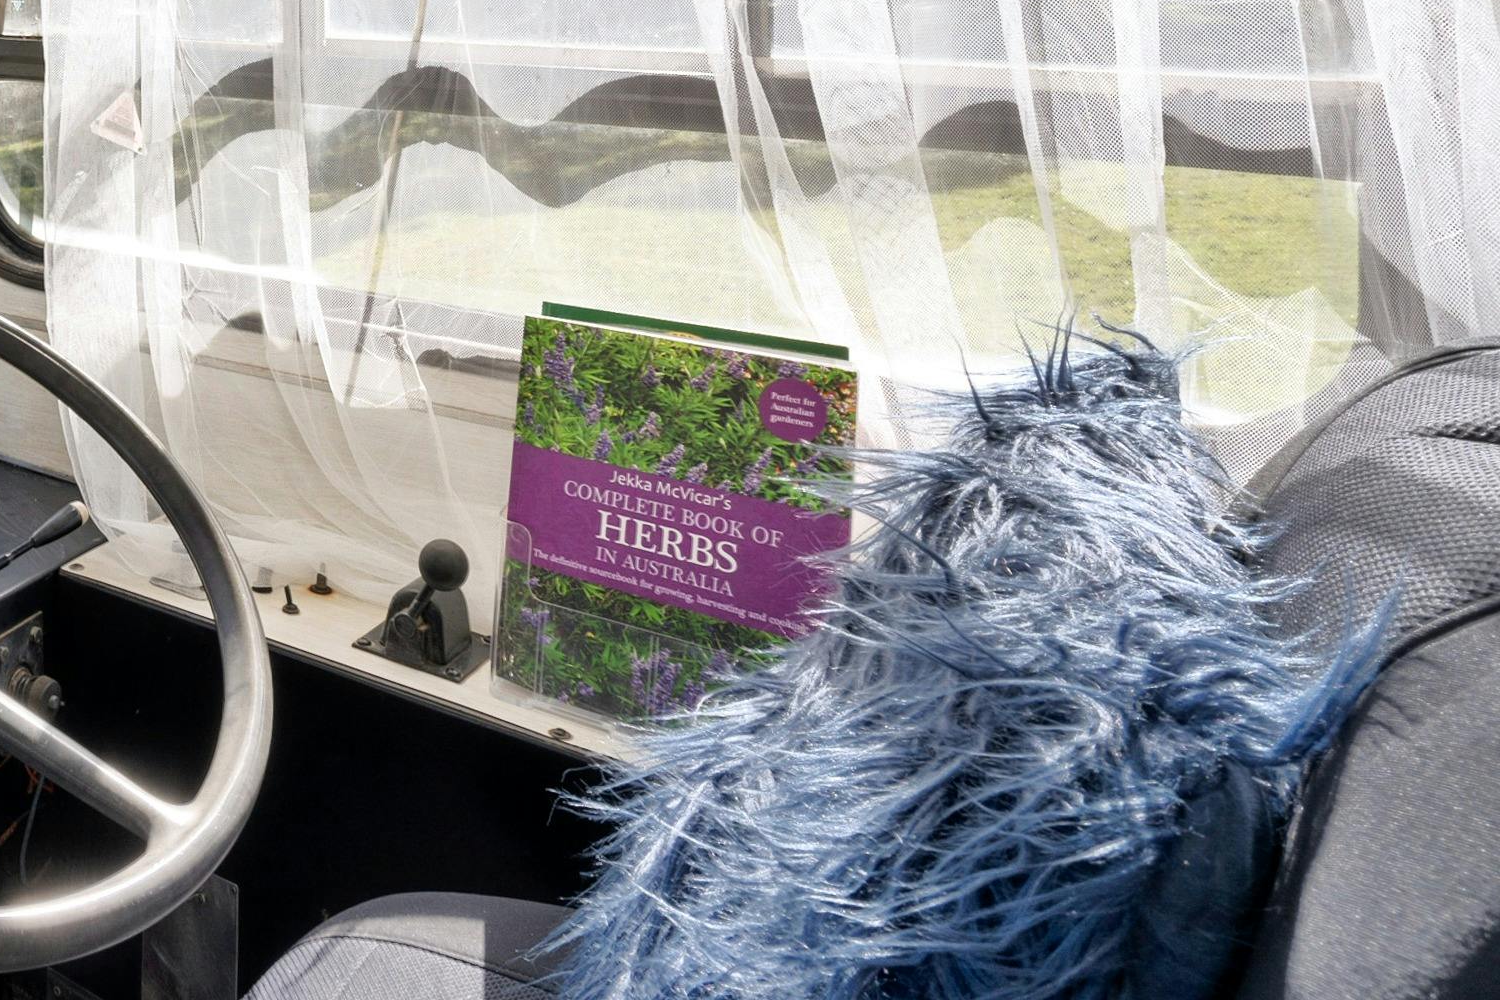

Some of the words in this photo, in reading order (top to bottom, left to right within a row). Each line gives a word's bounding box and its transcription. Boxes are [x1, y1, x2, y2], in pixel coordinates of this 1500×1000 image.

[770, 402, 815, 417] Australian
[770, 414, 814, 428] gardeners
[771, 391, 801, 404] Perfect
[803, 397, 816, 407] for
[609, 470, 652, 492] Jekka
[656, 480, 732, 511] McVicar's
[564, 480, 675, 522] COMPLETE
[681, 507, 745, 539] BOOK
[752, 525, 784, 548] OF
[595, 509, 738, 573] HERBS
[533, 548, 549, 560] The
[550, 554, 587, 571] definitive
[589, 566, 638, 585] sourcebook
[639, 577, 653, 590] for
[697, 594, 746, 619] harvesting
[747, 611, 767, 622] and
[596, 546, 618, 565] IN
[622, 553, 735, 598] AUSTRALIA
